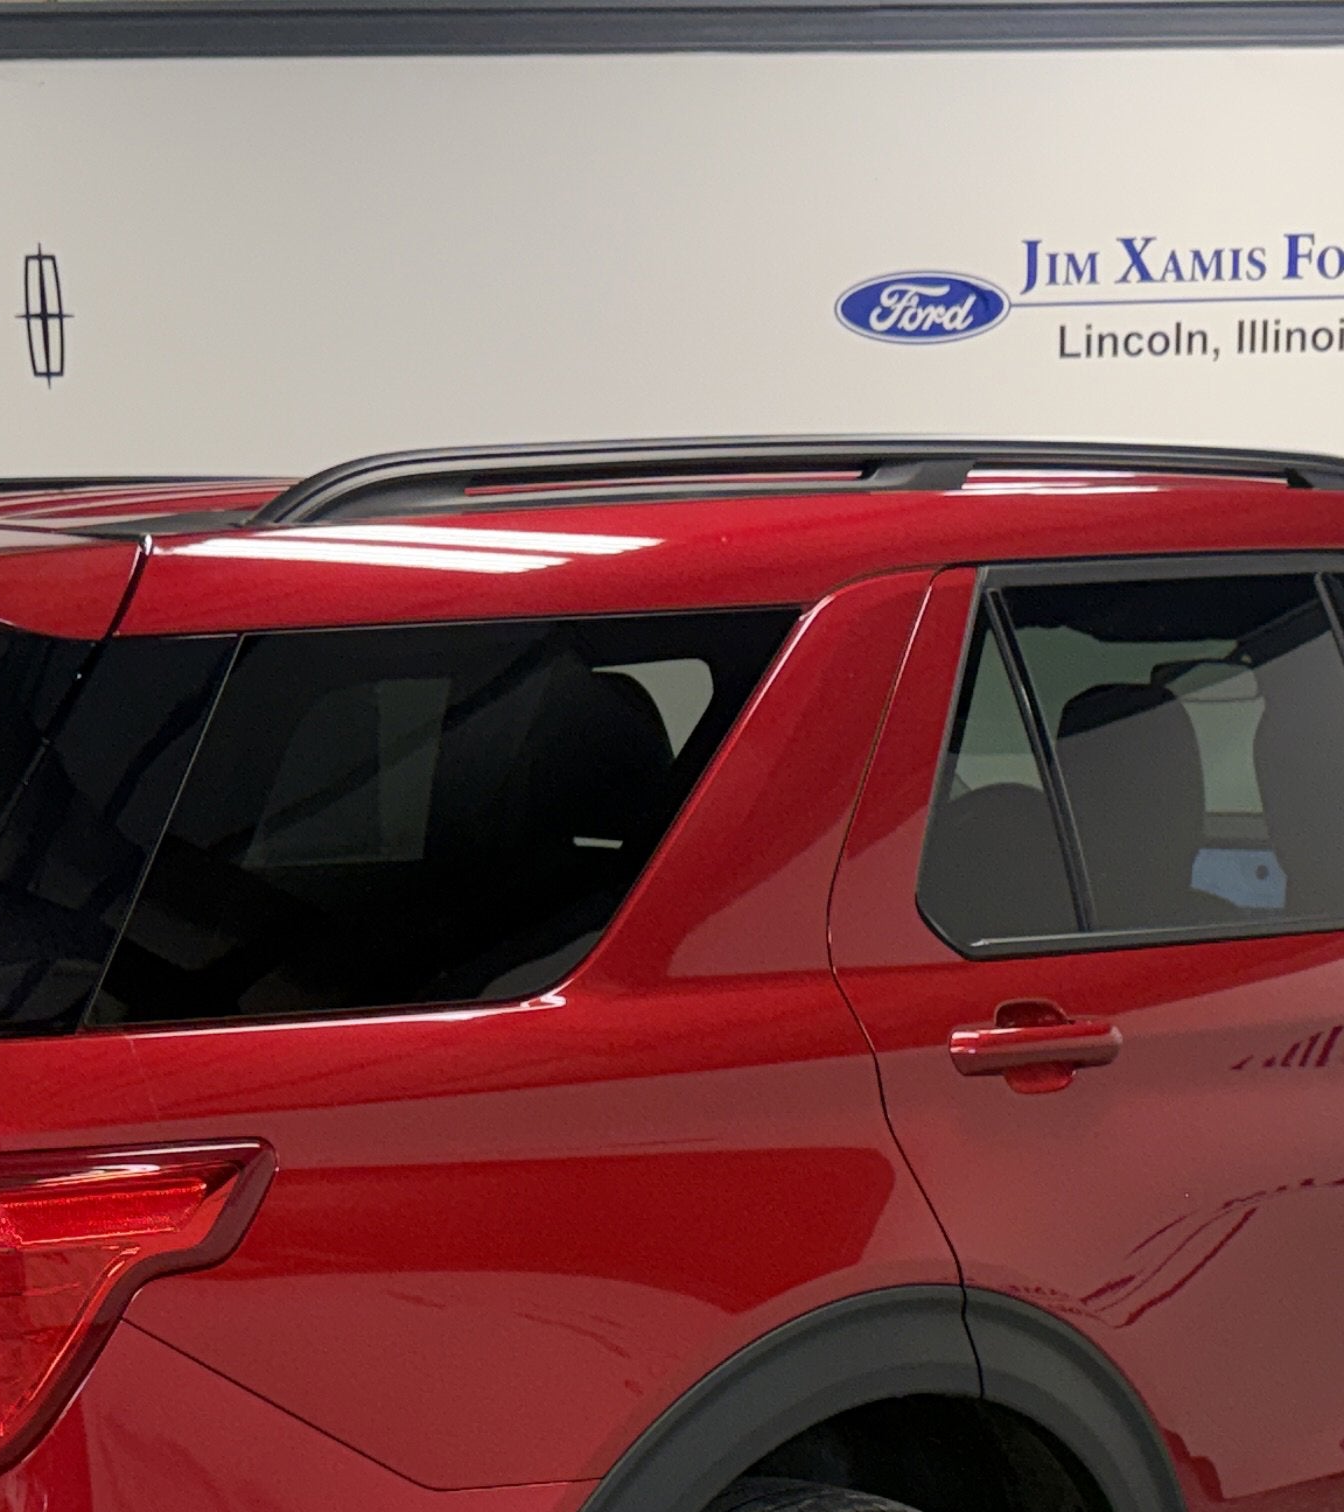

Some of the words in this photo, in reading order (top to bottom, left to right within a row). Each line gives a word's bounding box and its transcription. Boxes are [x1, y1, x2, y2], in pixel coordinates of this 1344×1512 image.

[1020, 239, 1100, 294] JIM
[1116, 235, 1267, 284] XAMIS
[870, 283, 973, 331] Ford
[1058, 320, 1222, 361] Lincoln,
